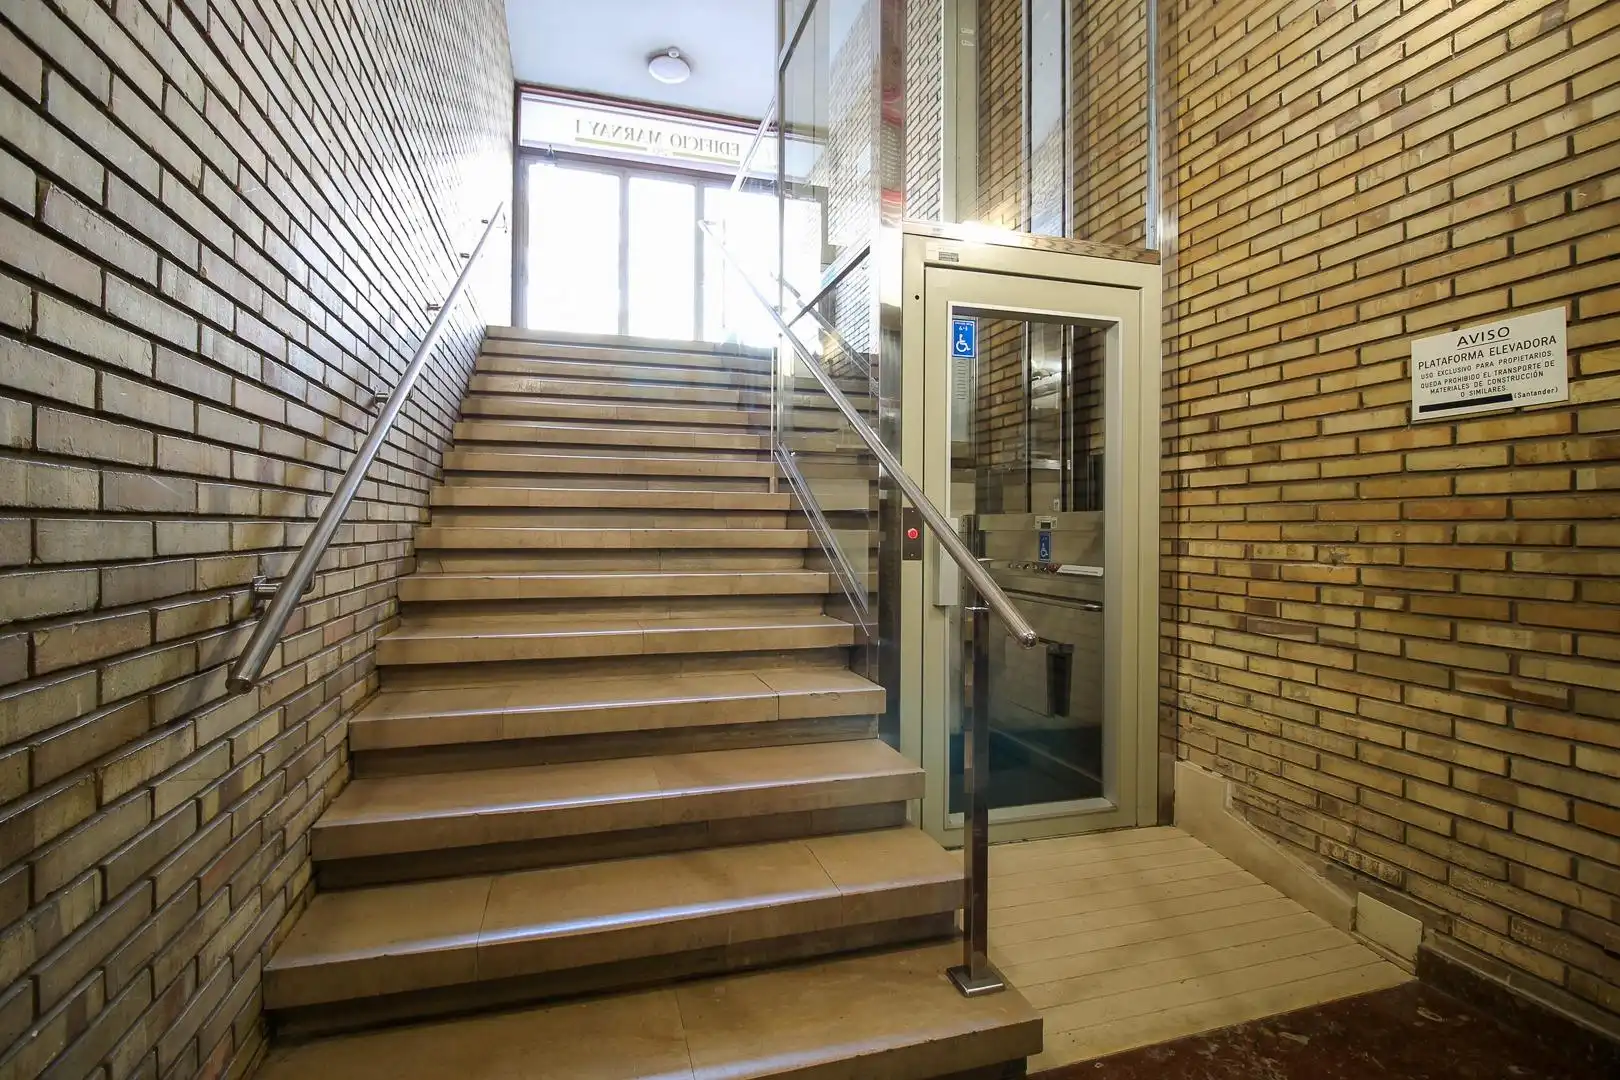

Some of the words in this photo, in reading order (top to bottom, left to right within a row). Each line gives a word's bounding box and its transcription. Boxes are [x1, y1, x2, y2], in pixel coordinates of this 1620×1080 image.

[1456, 326, 1510, 347] AVISO
[1418, 350, 1485, 370] PLATAFORMA
[1489, 335, 1557, 356] ELEVADORA
[1420, 372, 1434, 380] USO
[1437, 365, 1472, 377] EXCLUSIVO
[1475, 361, 1495, 370] PARA
[1420, 380, 1442, 389] QUEDA
[1444, 373, 1481, 384] PROHIBIDO
[1483, 371, 1492, 379] EL
[1494, 362, 1542, 376] TRANSPORTE
[1544, 359, 1555, 368] DE
[1430, 383, 1470, 394] MATERIALES
[1473, 380, 1483, 388] DE
[1487, 370, 1544, 386] CONSTRUCCIÓN
[1513, 387, 1559, 399] (Santander)
